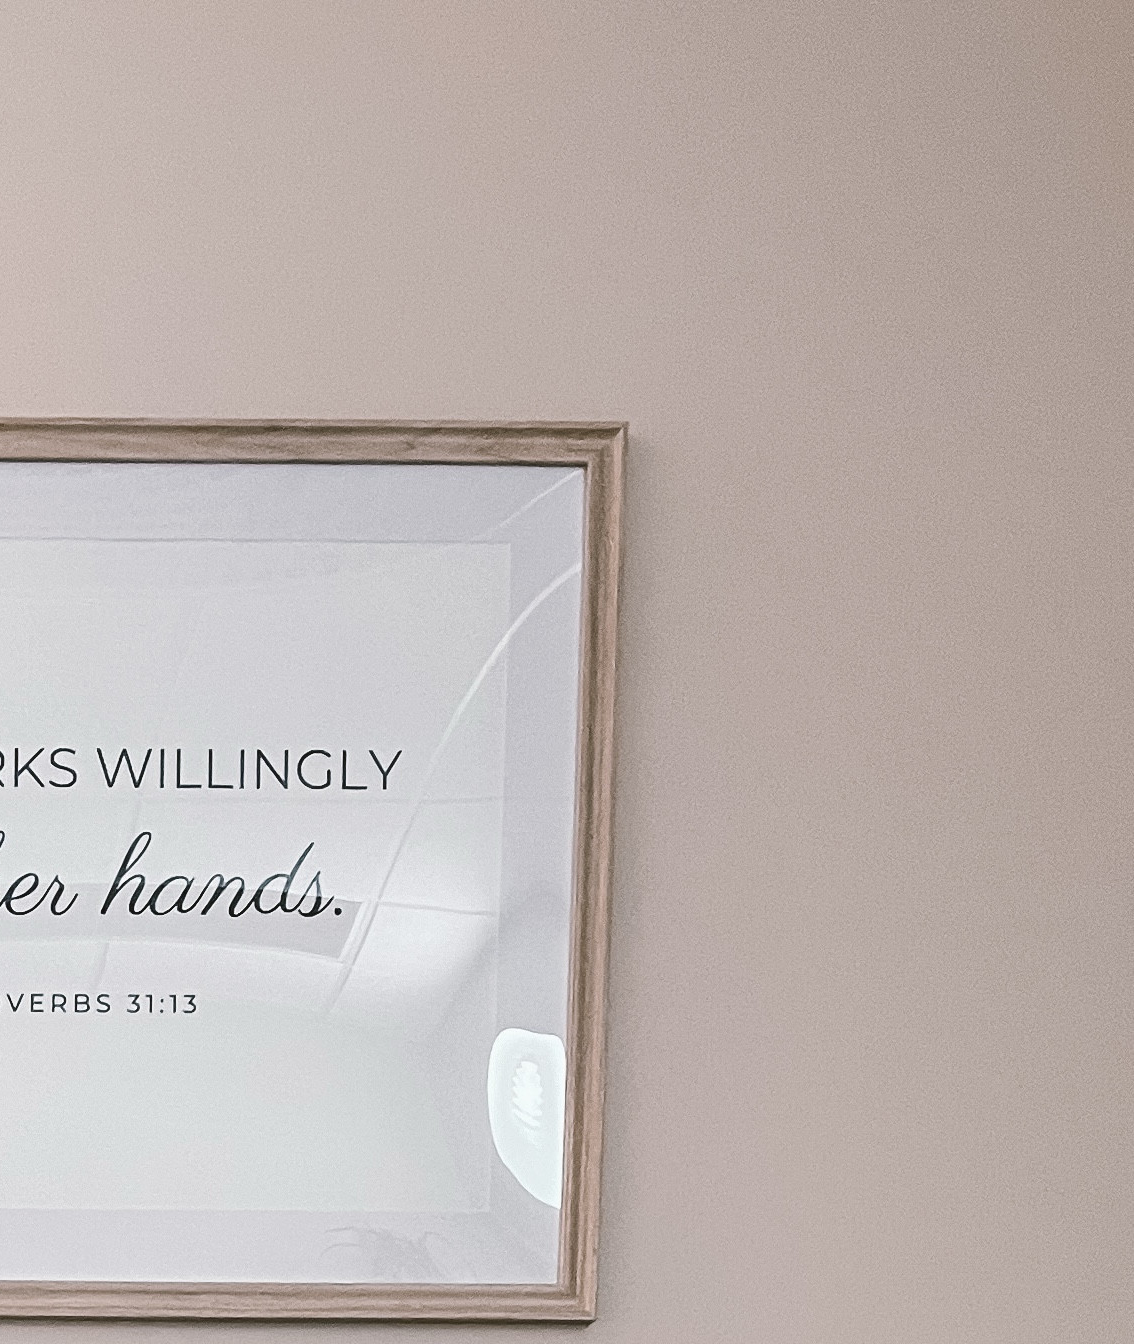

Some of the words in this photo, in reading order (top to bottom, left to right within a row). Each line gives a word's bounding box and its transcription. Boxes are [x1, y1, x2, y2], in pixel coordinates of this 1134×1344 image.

[96, 746, 404, 791] WILLINGLY
[99, 830, 344, 918] hands.
[125, 992, 198, 1015] 31:13
